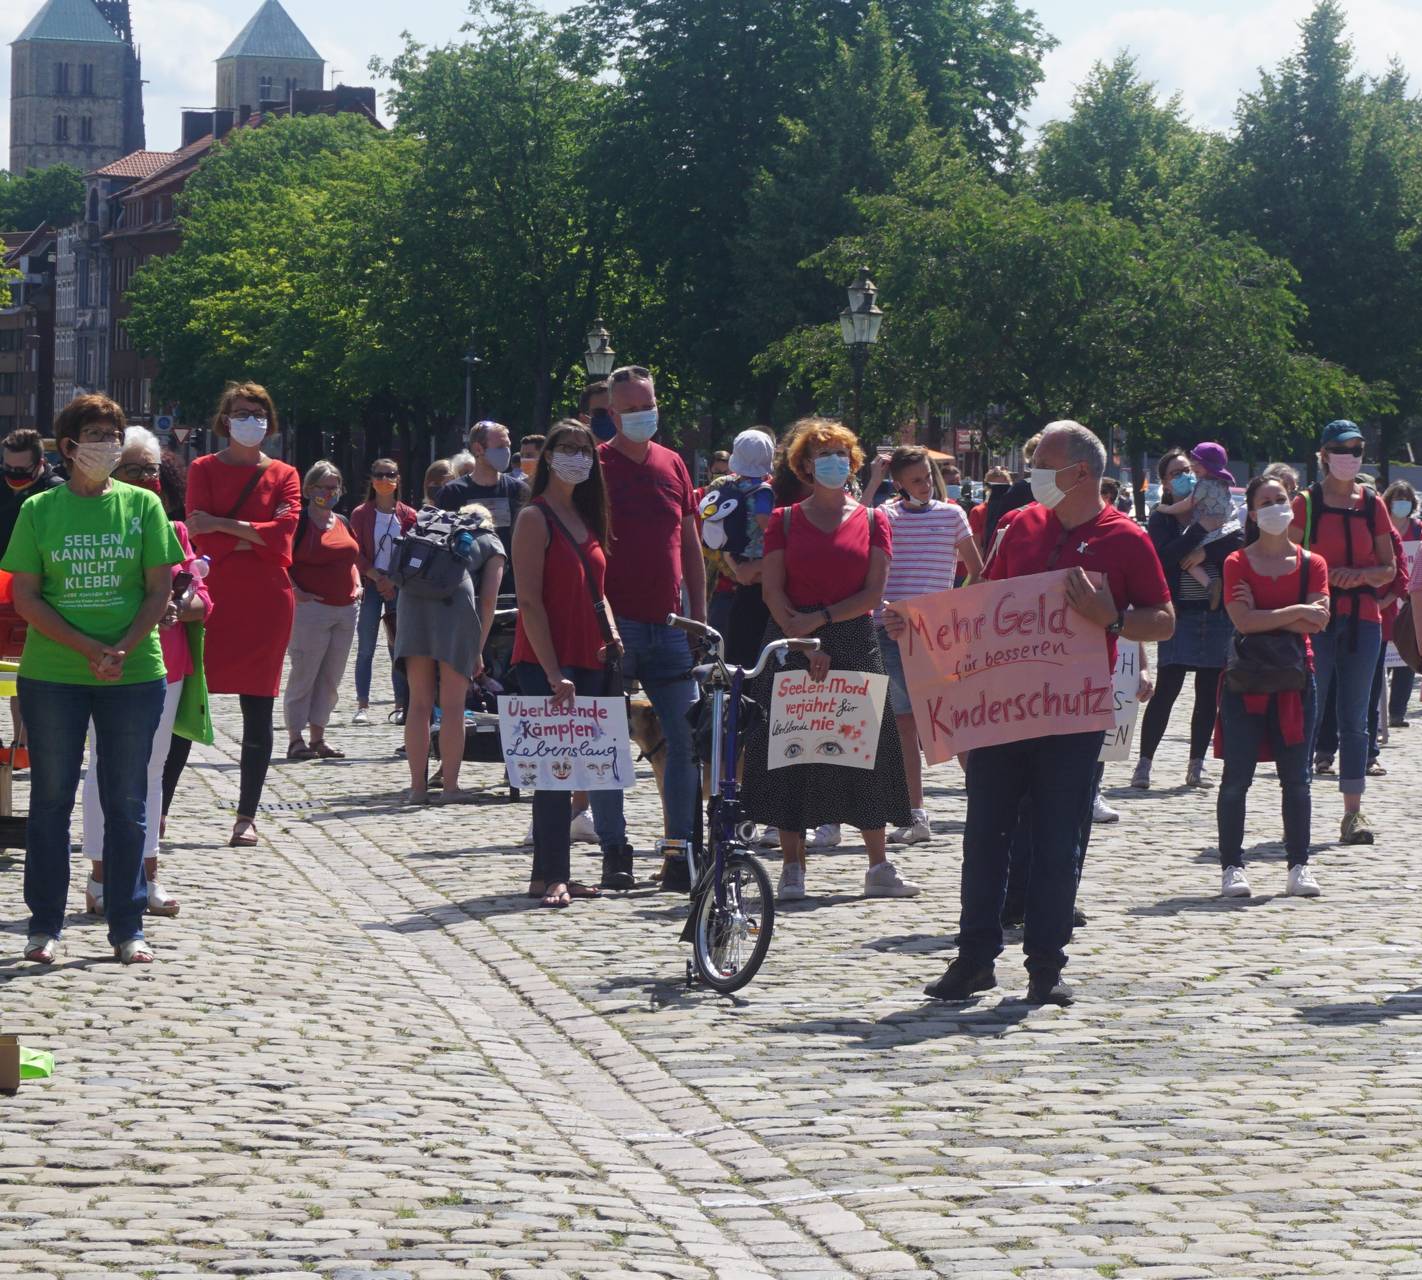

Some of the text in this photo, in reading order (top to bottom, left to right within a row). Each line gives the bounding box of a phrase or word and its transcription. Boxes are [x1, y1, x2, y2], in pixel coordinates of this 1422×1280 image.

[64, 533, 121, 547] SEELEN
[51, 546, 135, 563] KANN MAN
[71, 560, 117, 575] NICHT
[908, 592, 1077, 656] Mehr Geld
[952, 641, 1069, 682] für besseren
[785, 697, 858, 720] verjährt für
[927, 676, 1113, 742] Kinderschutz
[810, 716, 835, 731] nie
